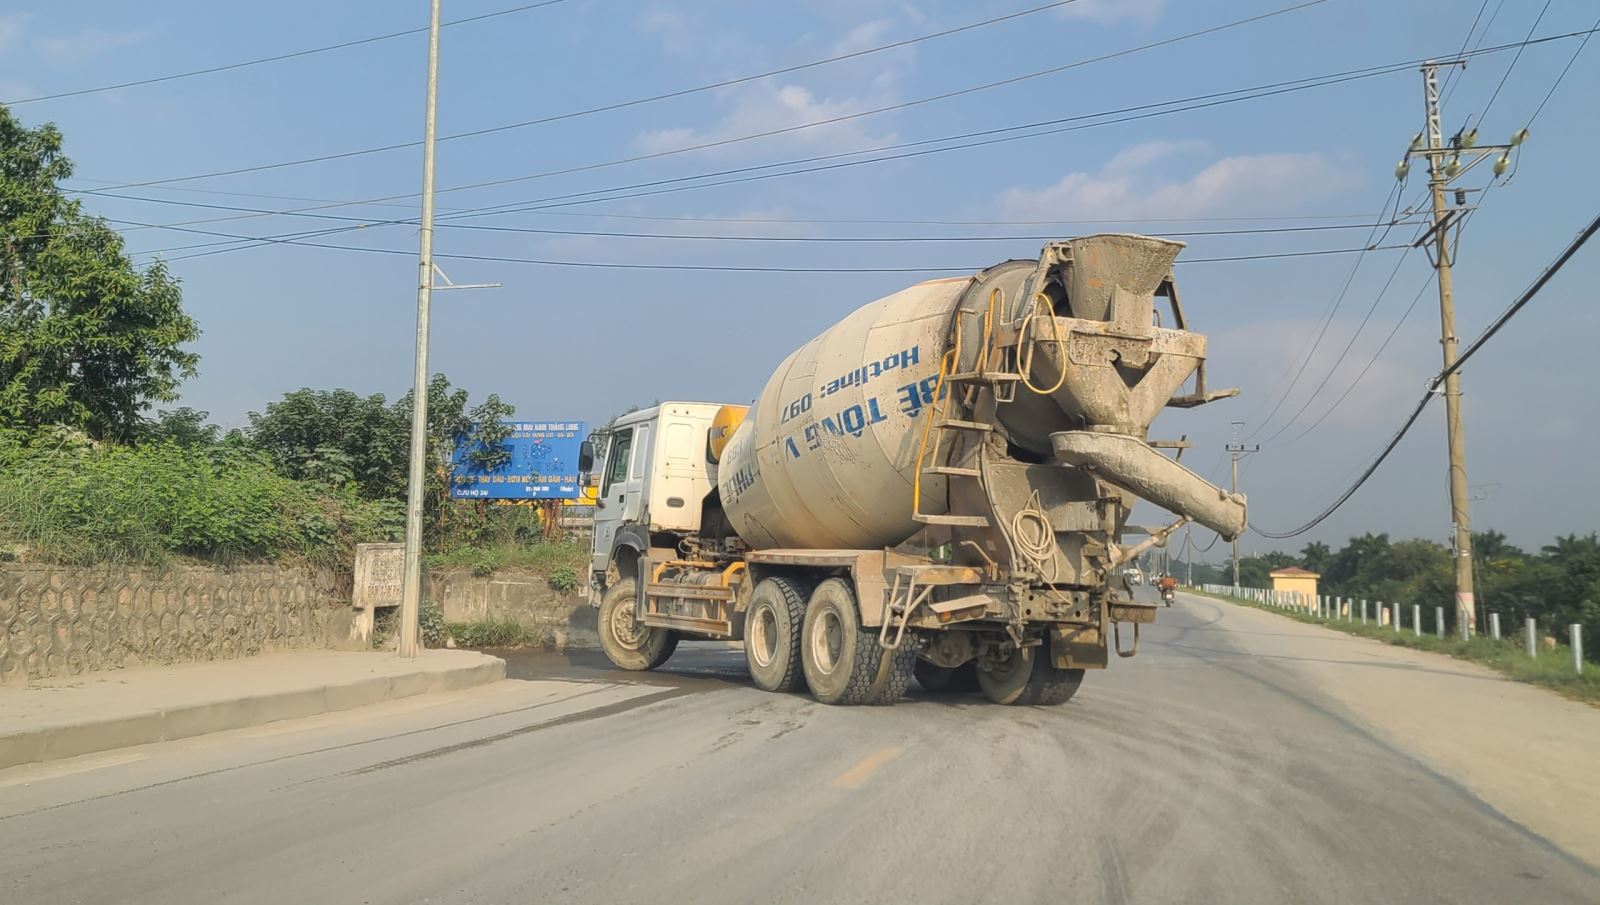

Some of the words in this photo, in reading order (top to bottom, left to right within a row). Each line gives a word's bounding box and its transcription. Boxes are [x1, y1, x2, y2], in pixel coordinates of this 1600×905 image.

[819, 345, 920, 399] Hotline:
[896, 373, 947, 418] BÊ
[781, 391, 813, 425] 097
[804, 396, 888, 451] TÔNG
